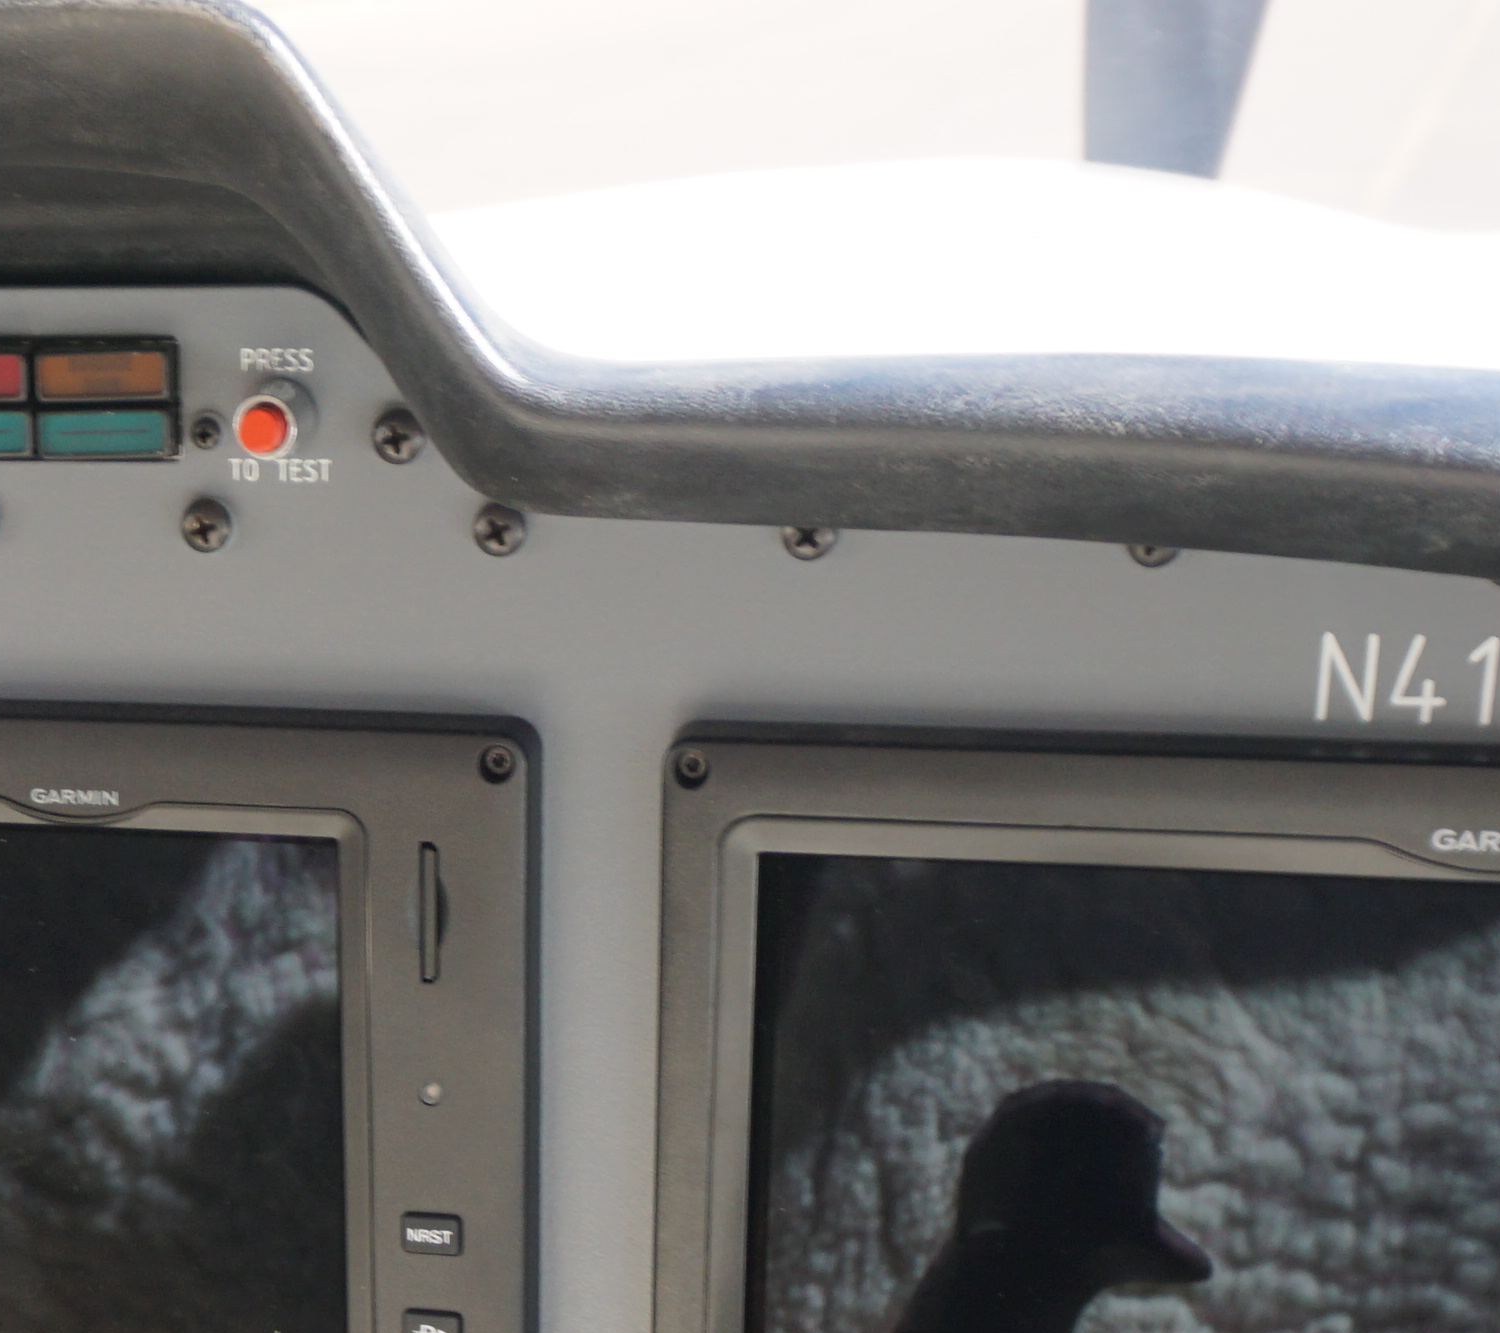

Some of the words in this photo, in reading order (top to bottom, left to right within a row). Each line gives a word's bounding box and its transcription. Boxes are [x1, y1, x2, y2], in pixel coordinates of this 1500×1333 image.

[240, 347, 314, 372] PRESS
[227, 458, 260, 482] TO
[275, 458, 332, 483] TEST
[30, 787, 119, 807] GARMIN
[406, 1228, 453, 1246] NRST
